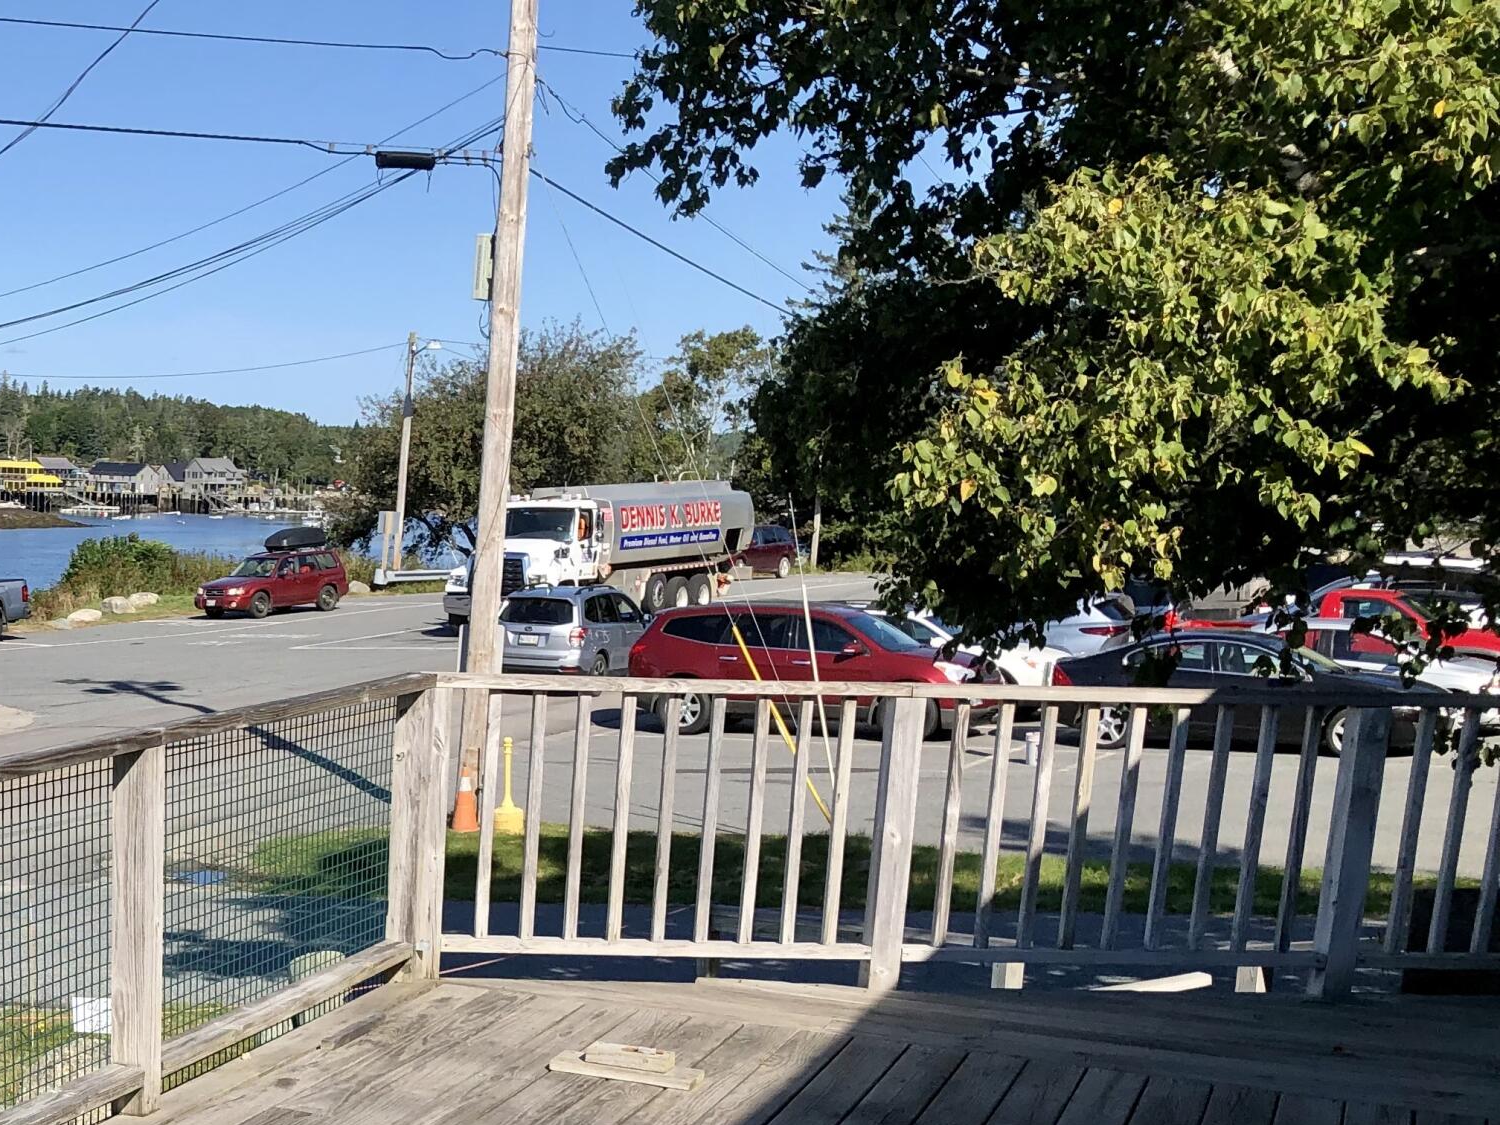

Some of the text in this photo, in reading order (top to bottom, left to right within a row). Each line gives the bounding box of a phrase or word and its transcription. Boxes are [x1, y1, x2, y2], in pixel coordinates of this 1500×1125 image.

[620, 505, 667, 532] DENNIS
[669, 504, 683, 528] K.
[684, 500, 721, 527] BURKE
[623, 537, 643, 548] Premium
[643, 536, 657, 545] Diesel
[682, 533, 690, 542] Oil
[690, 532, 698, 542] and
